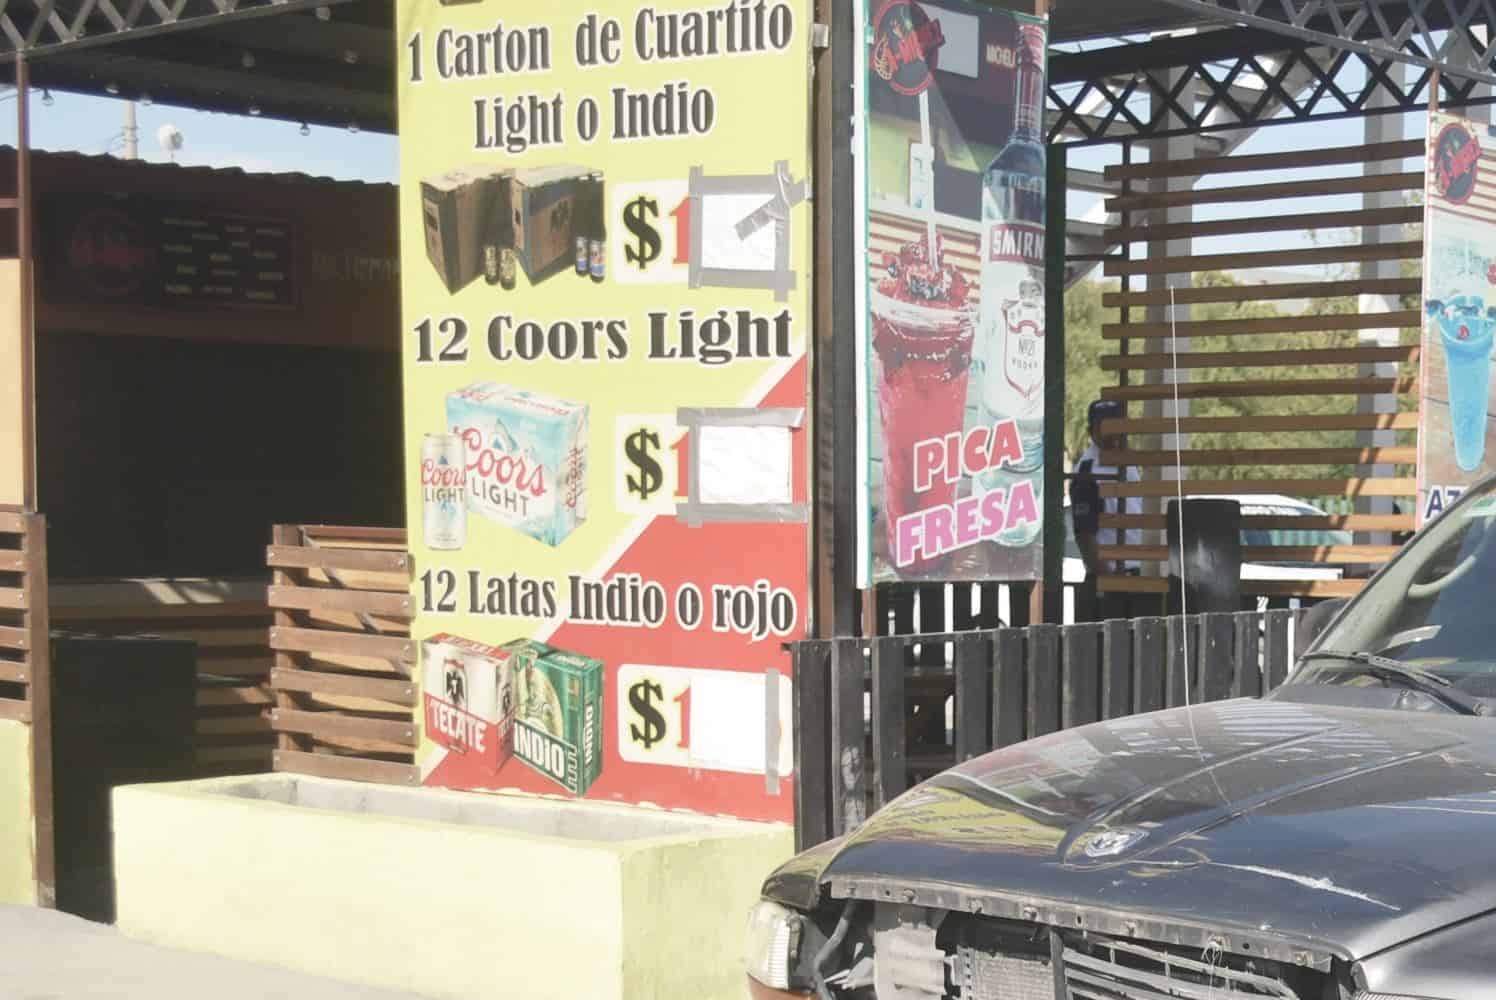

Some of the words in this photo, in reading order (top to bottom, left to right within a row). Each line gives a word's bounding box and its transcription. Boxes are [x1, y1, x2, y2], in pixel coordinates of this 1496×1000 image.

[408, 33, 422, 81] 1
[436, 25, 550, 78] Carton
[576, 15, 620, 65] de
[635, 0, 792, 60] Cuartito
[474, 92, 562, 153] Light
[577, 99, 598, 141] o
[612, 82, 714, 138] Indio
[413, 317, 468, 362] 12
[487, 315, 628, 360] Coors
[648, 310, 792, 365] Light
[454, 426, 547, 496] Coors
[914, 419, 1024, 492] PICA
[425, 488, 464, 502] LIGHT
[472, 477, 530, 516] LIGHT
[896, 480, 1040, 567] FRESA
[419, 570, 456, 613] 12
[469, 572, 556, 618] Latas
[569, 575, 664, 625] Indio
[678, 587, 700, 626] o
[715, 582, 794, 637] rojo
[430, 700, 487, 753] TECATE
[514, 721, 566, 779] INDIO
